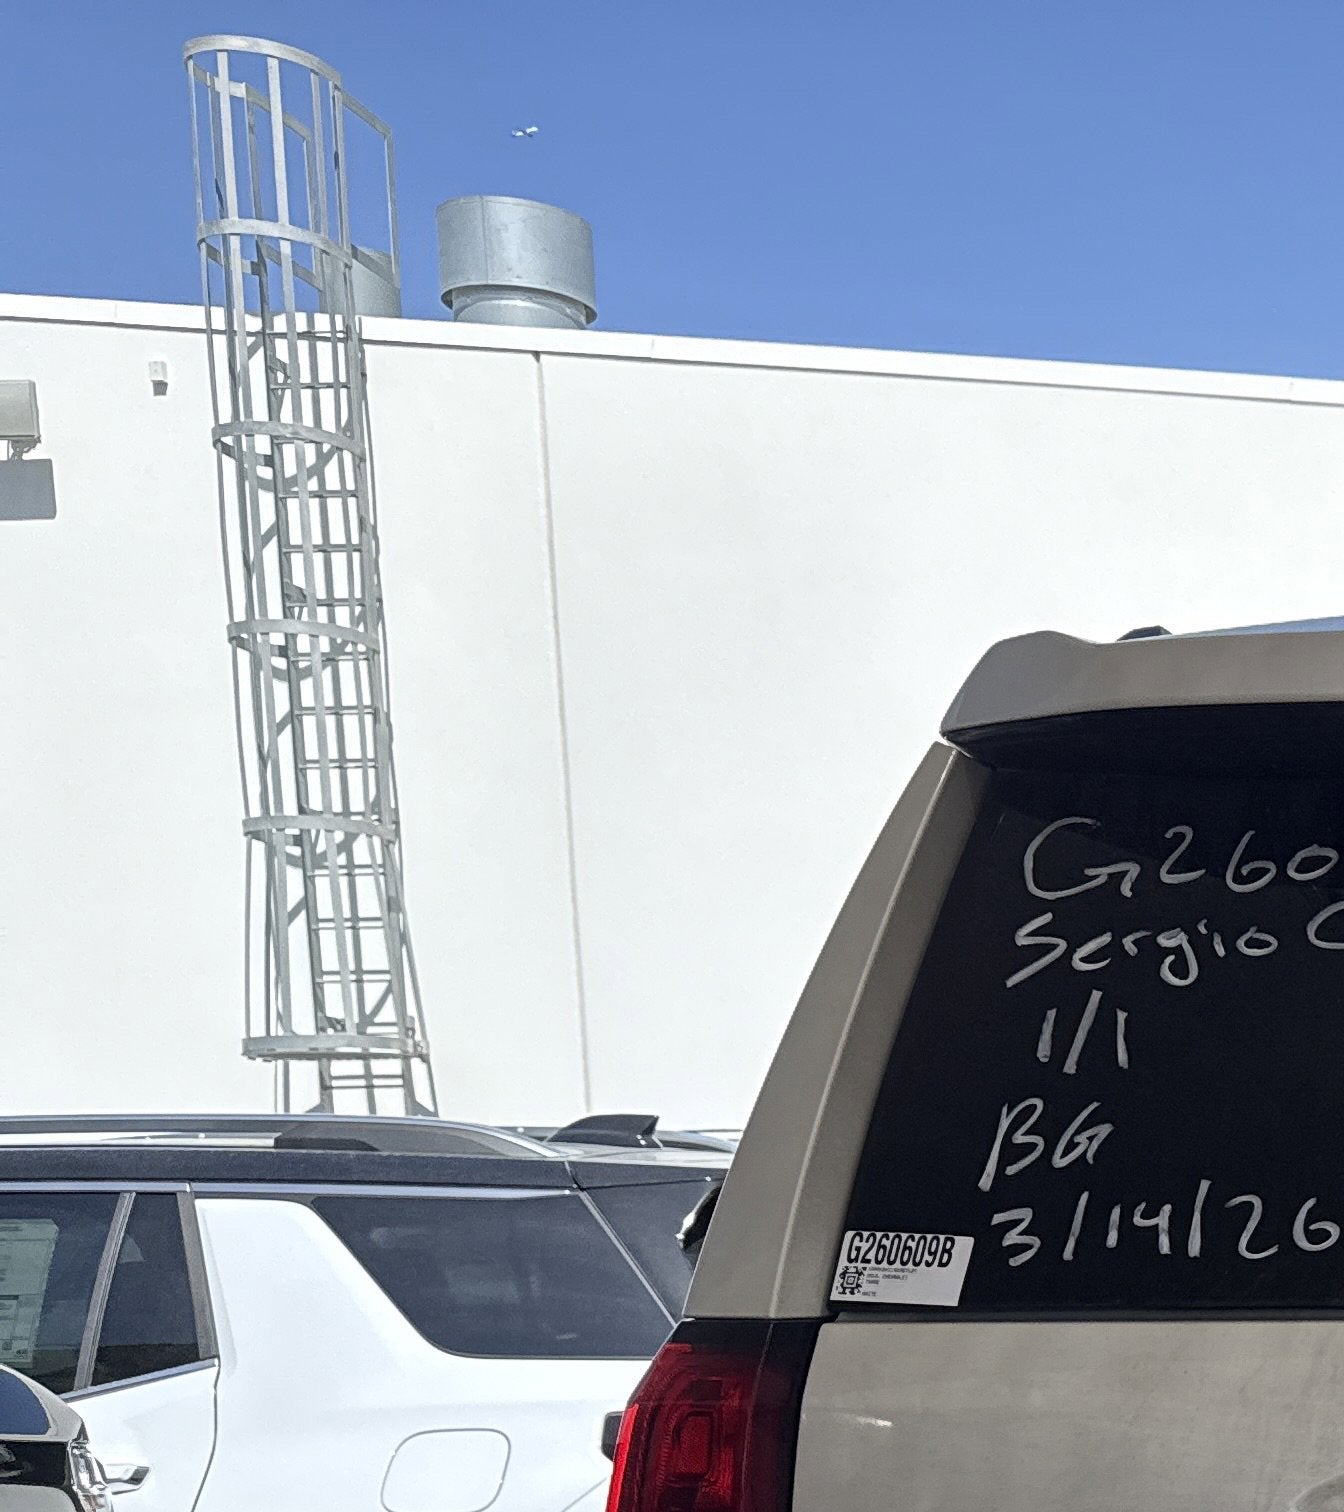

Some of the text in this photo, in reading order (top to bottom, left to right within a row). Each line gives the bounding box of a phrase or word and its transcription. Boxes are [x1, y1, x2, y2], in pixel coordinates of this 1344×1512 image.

[1005, 911, 1279, 988] Sergio
[976, 1096, 1114, 1192] BG
[846, 1231, 956, 1268] G260609B
[990, 1179, 1342, 1267] 3/14/26
